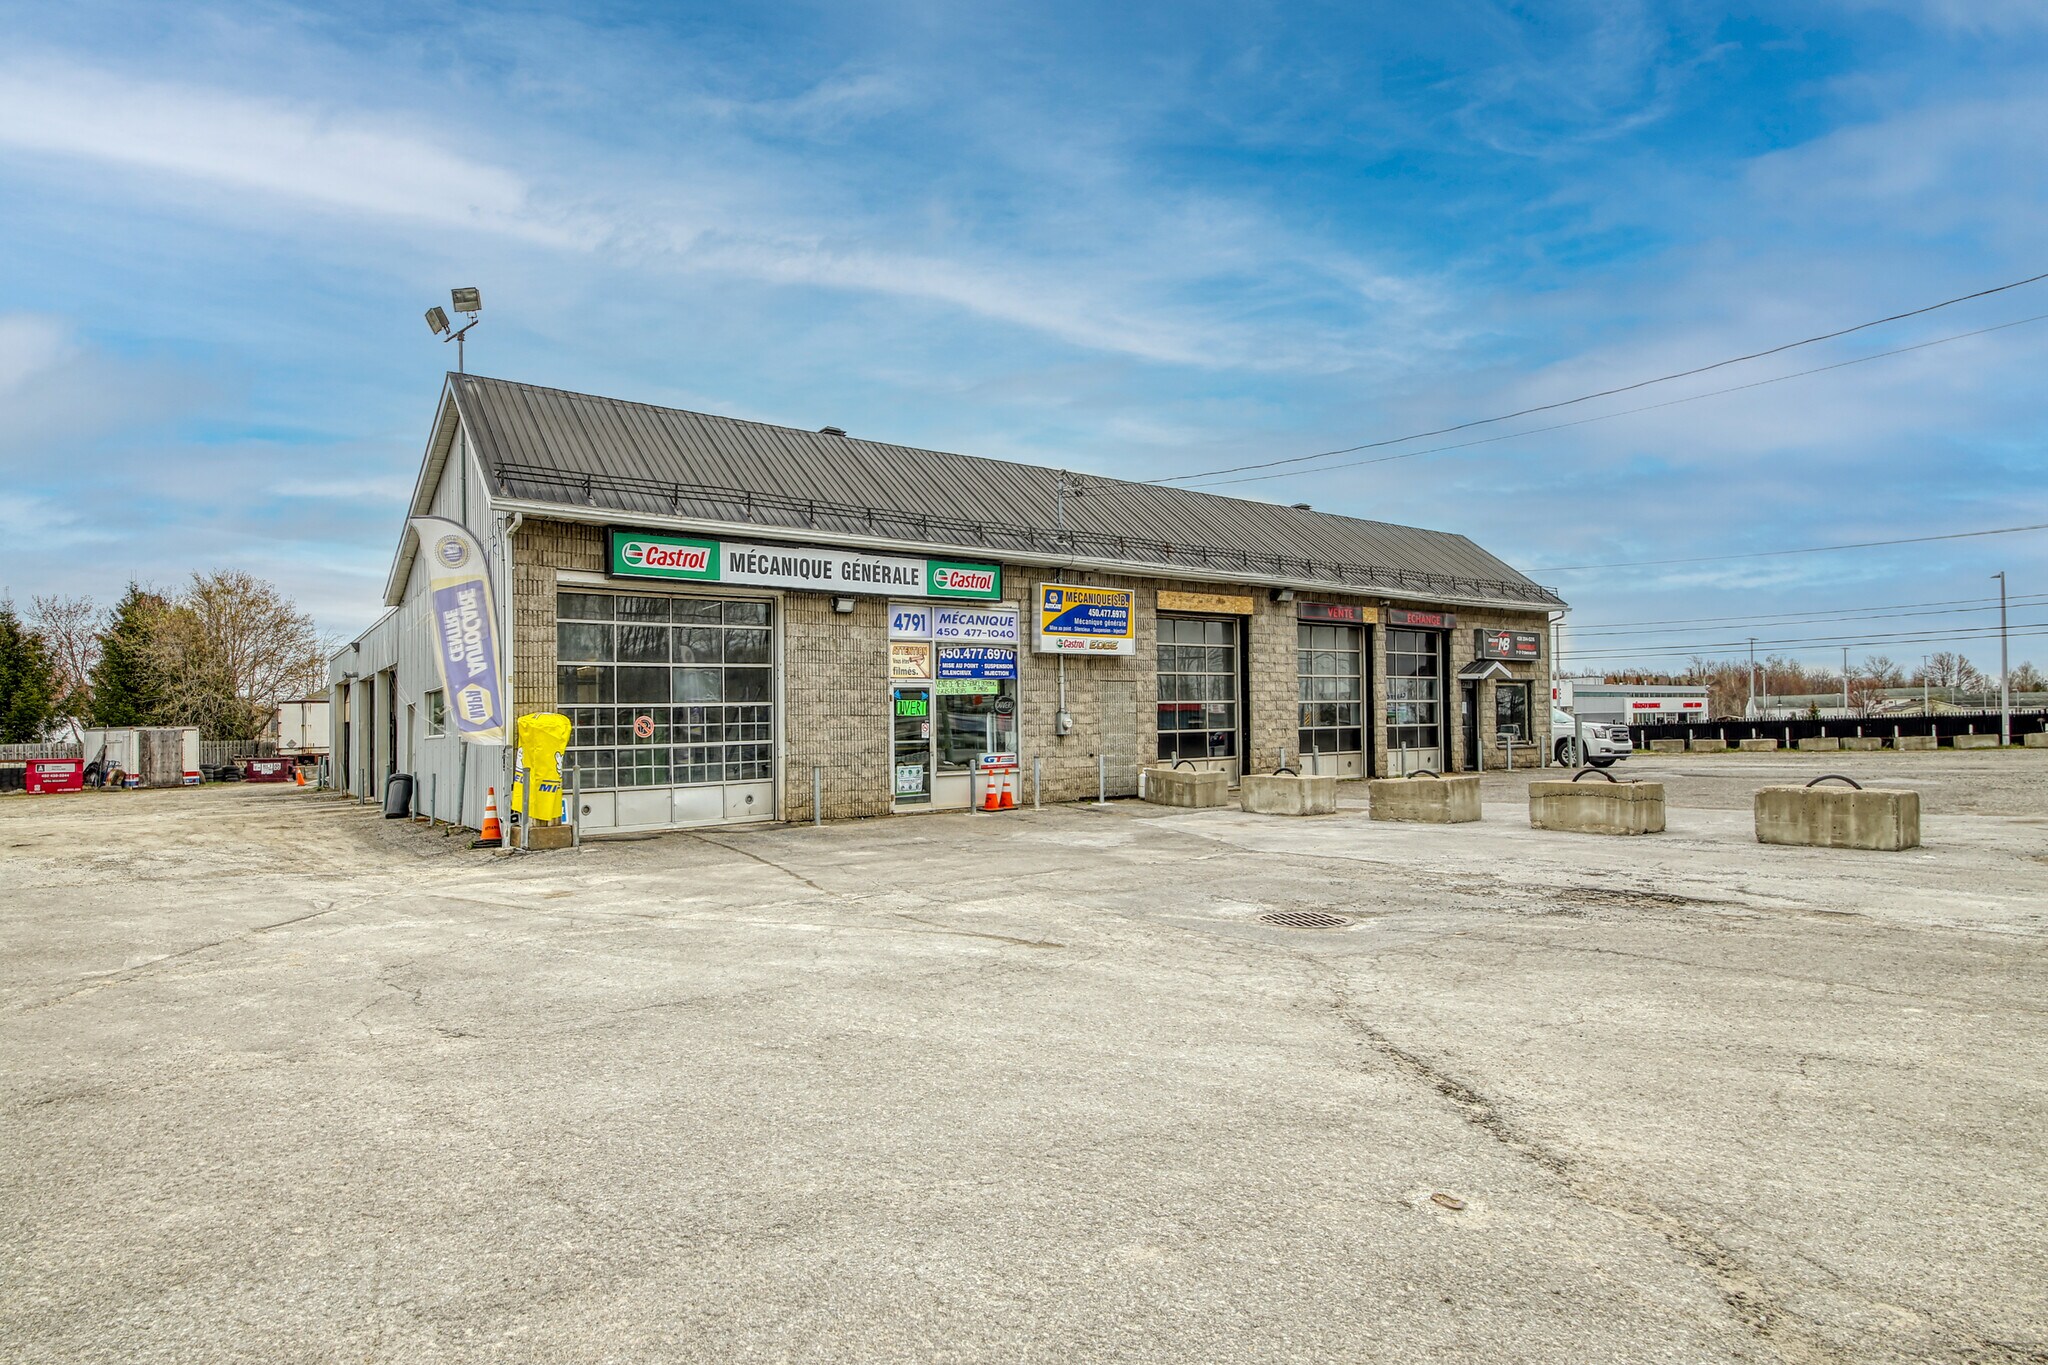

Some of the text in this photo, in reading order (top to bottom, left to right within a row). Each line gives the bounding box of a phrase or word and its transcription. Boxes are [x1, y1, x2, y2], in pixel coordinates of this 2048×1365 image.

[645, 544, 706, 570] Castrol
[730, 548, 920, 586] MÉCANIQUE GÉNÉRALE
[949, 570, 993, 591] Castrol
[1065, 589, 1112, 606] MÉCANIQUE
[939, 611, 1015, 627] MÉCANIQUE
[1088, 608, 1127, 618] 450.477.6970
[1327, 607, 1354, 619] VENTE
[893, 613, 926, 632] 4791
[1074, 617, 1127, 627] Mécanique générale
[936, 628, 1014, 638] 450 477-1040
[1063, 639, 1085, 648] Castrol
[892, 645, 928, 656] ATTENTION
[940, 647, 1014, 660] 450.477.6970
